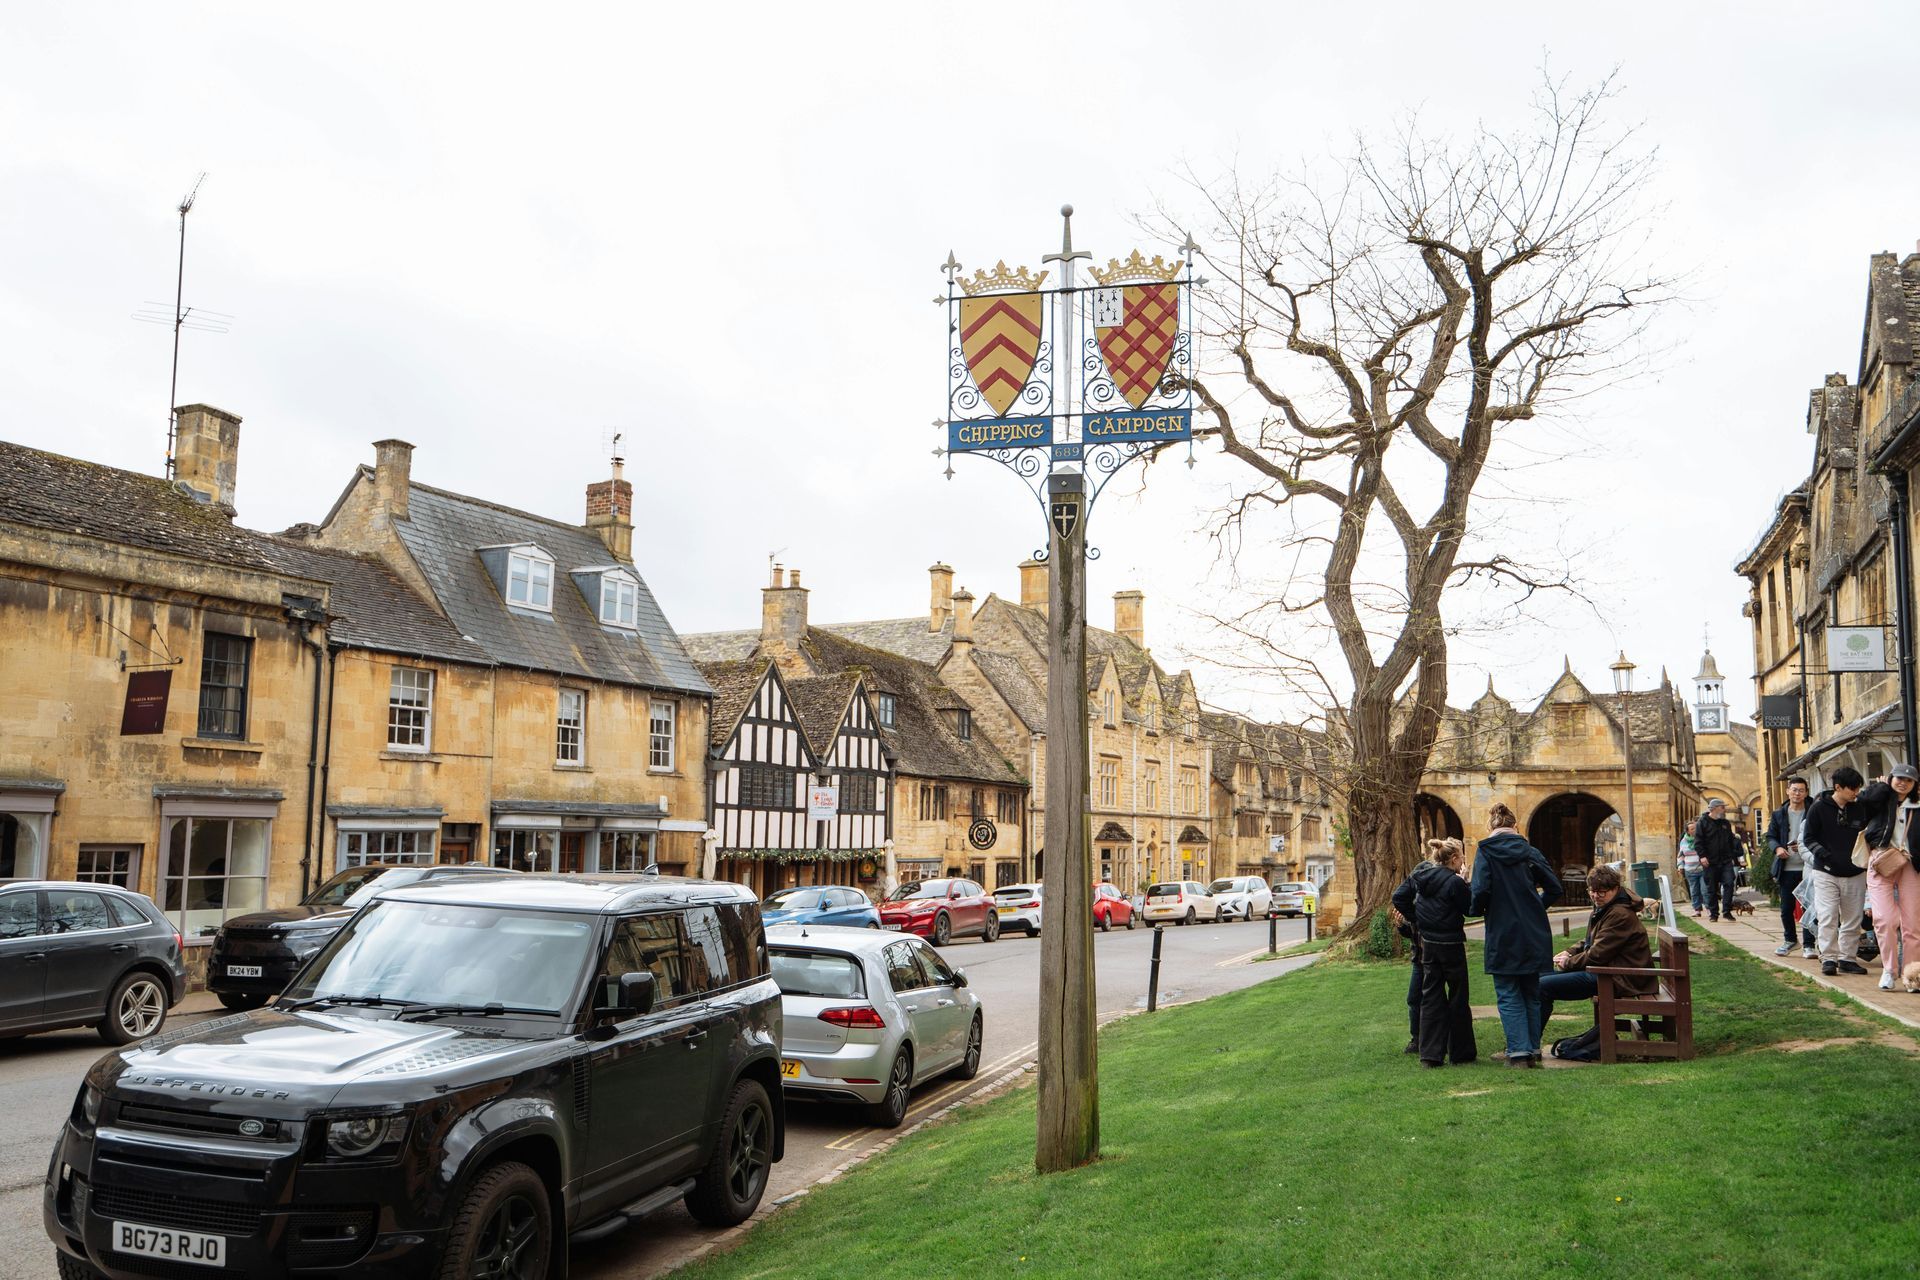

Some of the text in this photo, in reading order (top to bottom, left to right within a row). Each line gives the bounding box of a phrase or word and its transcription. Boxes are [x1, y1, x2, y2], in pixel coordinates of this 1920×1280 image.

[958, 415, 1184, 445] CHIPPING CAMPDEN
[1054, 447, 1080, 457] 689
[133, 1076, 290, 1100] DEFENDER
[121, 1226, 218, 1261] BG73 RJO
